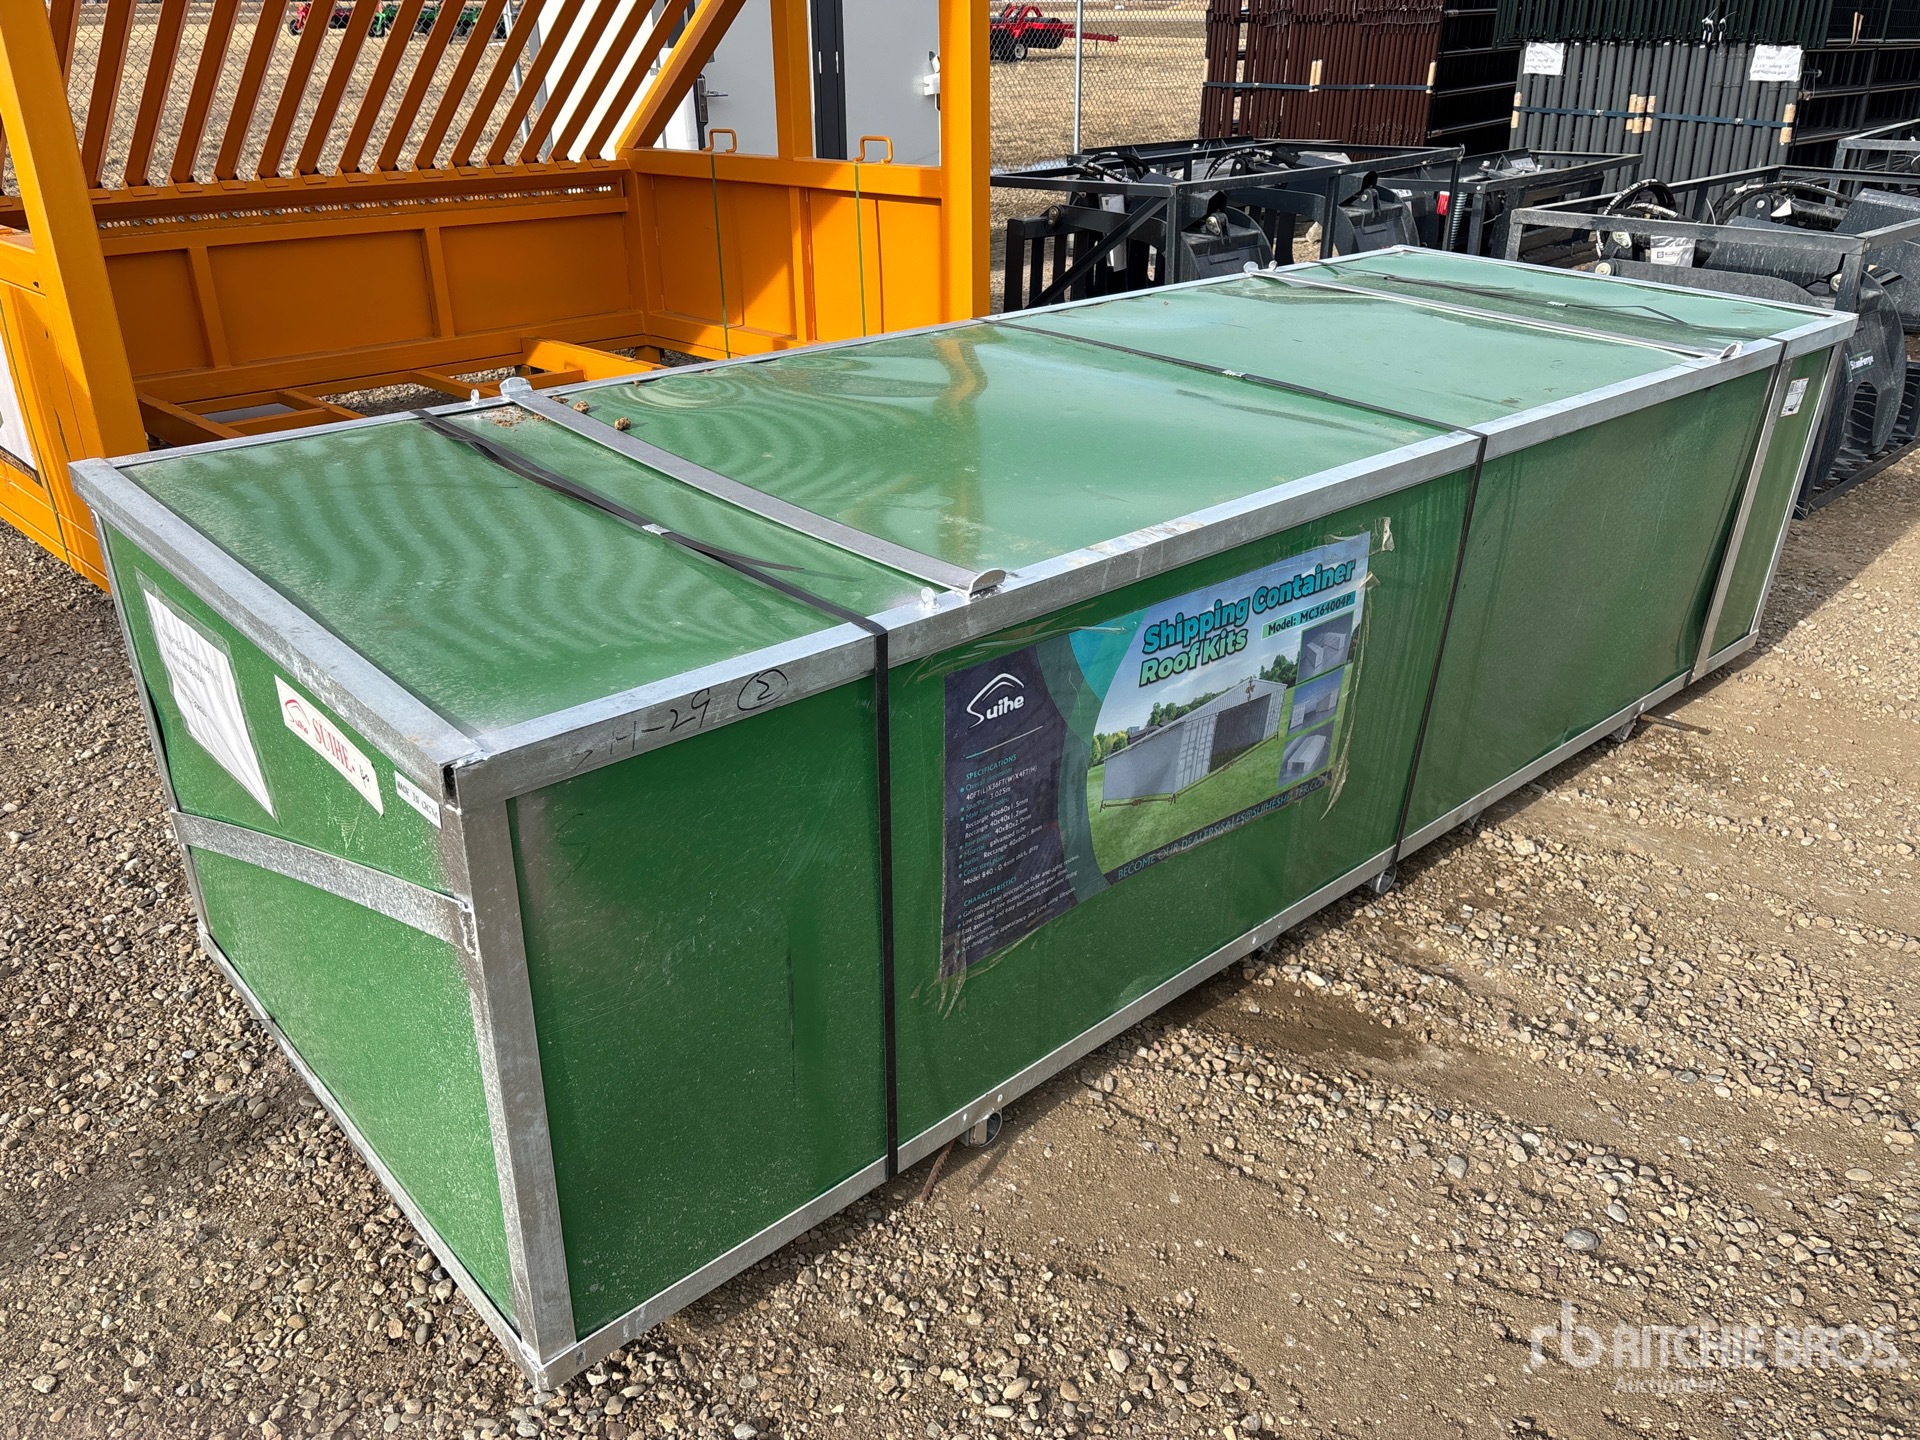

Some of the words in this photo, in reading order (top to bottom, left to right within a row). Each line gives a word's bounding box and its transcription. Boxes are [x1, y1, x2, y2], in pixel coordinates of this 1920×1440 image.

[1142, 596, 1250, 654] Shipping
[1252, 558, 1356, 614] Container
[1268, 618, 1296, 636] Model:
[1299, 594, 1352, 623] MC364004P
[1139, 641, 1200, 687] Roof
[1201, 629, 1248, 665] Kits
[966, 673, 1025, 729] Suihe
[312, 718, 355, 773] SUIHE
[965, 754, 1017, 780] SPECIFICATIONS
[963, 874, 980, 886] Model
[1118, 852, 1156, 879] BECOME
[963, 876, 1017, 907] CHARACTERISTICS
